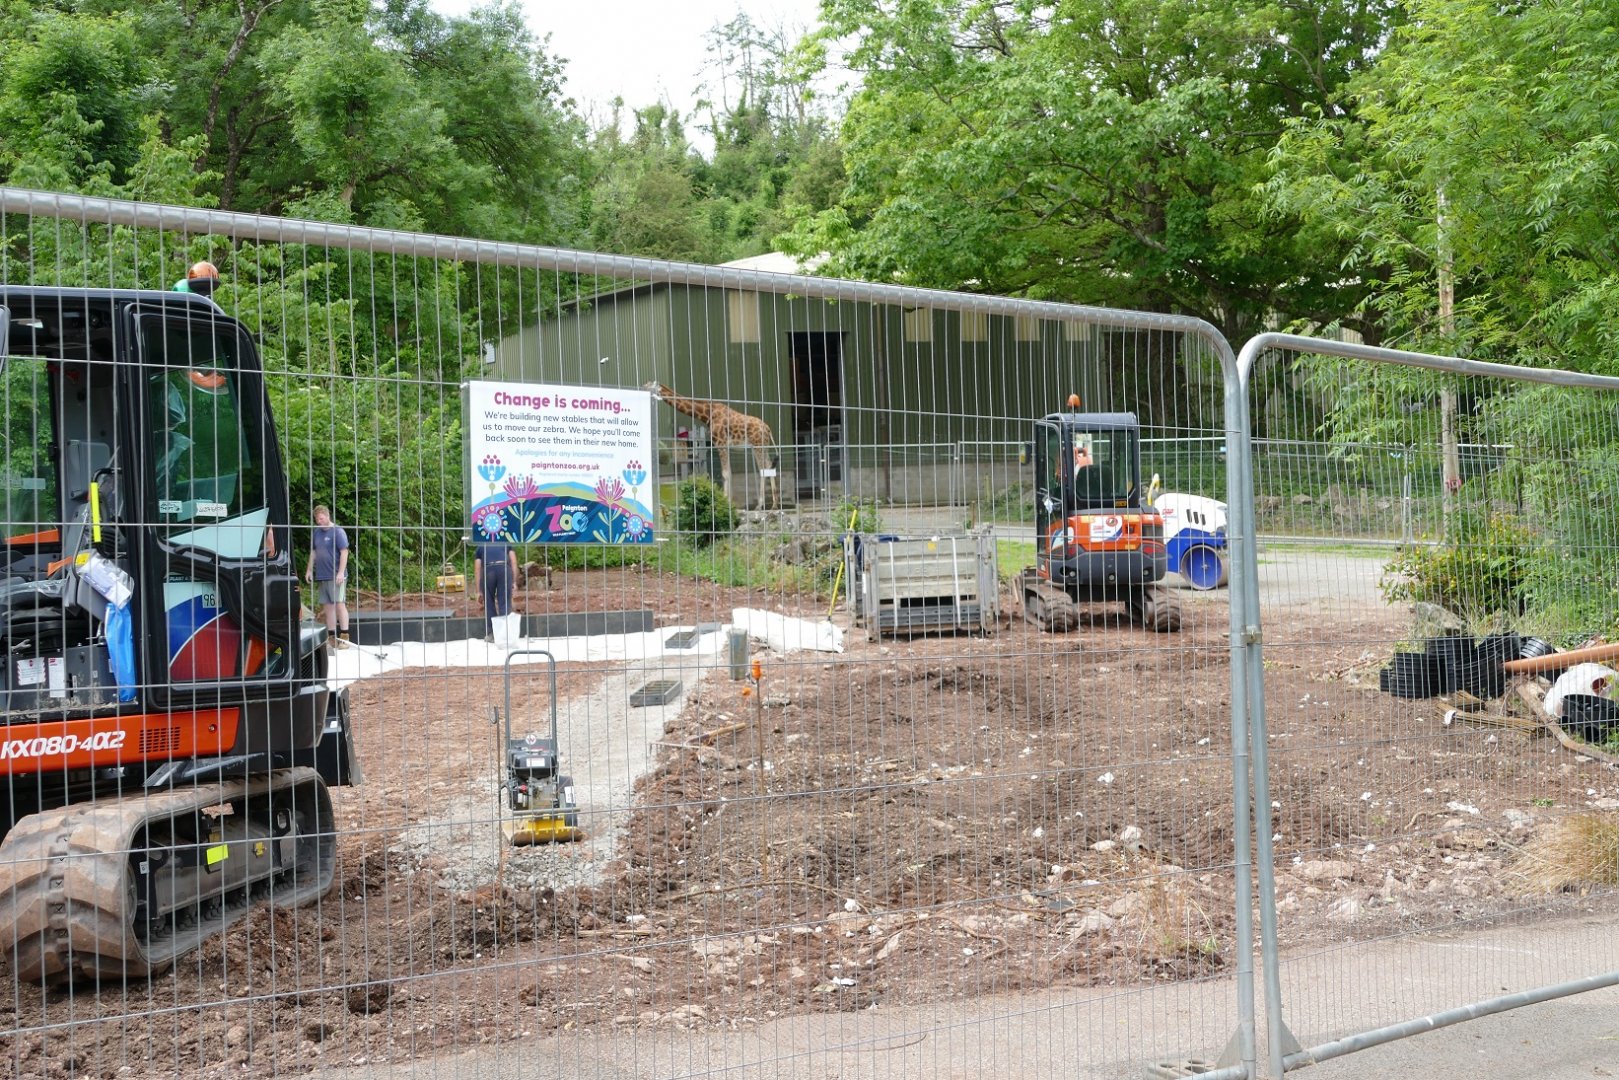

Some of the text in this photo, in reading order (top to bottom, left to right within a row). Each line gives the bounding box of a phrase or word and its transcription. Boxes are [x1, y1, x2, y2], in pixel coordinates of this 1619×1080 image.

[494, 391, 631, 414] Change is coming...
[484, 410, 508, 420] We're
[510, 412, 541, 423] building
[561, 415, 588, 424] stables
[590, 416, 606, 424] that
[607, 417, 619, 425] will
[620, 418, 639, 426] allow
[494, 423, 503, 431] to
[543, 425, 567, 433] zebra.
[568, 426, 581, 434] We
[583, 427, 601, 436] hope
[602, 428, 621, 437] you'll
[485, 433, 505, 442] back
[553, 436, 573, 444] them
[574, 437, 582, 445] in
[583, 438, 600, 446] their
[618, 439, 639, 448] home.
[515, 449, 547, 458] Apologies
[548, 449, 558, 457] for
[558, 450, 571, 458] any
[531, 461, 600, 471] paigntonzoo.org.uk
[562, 504, 588, 512] Paignton
